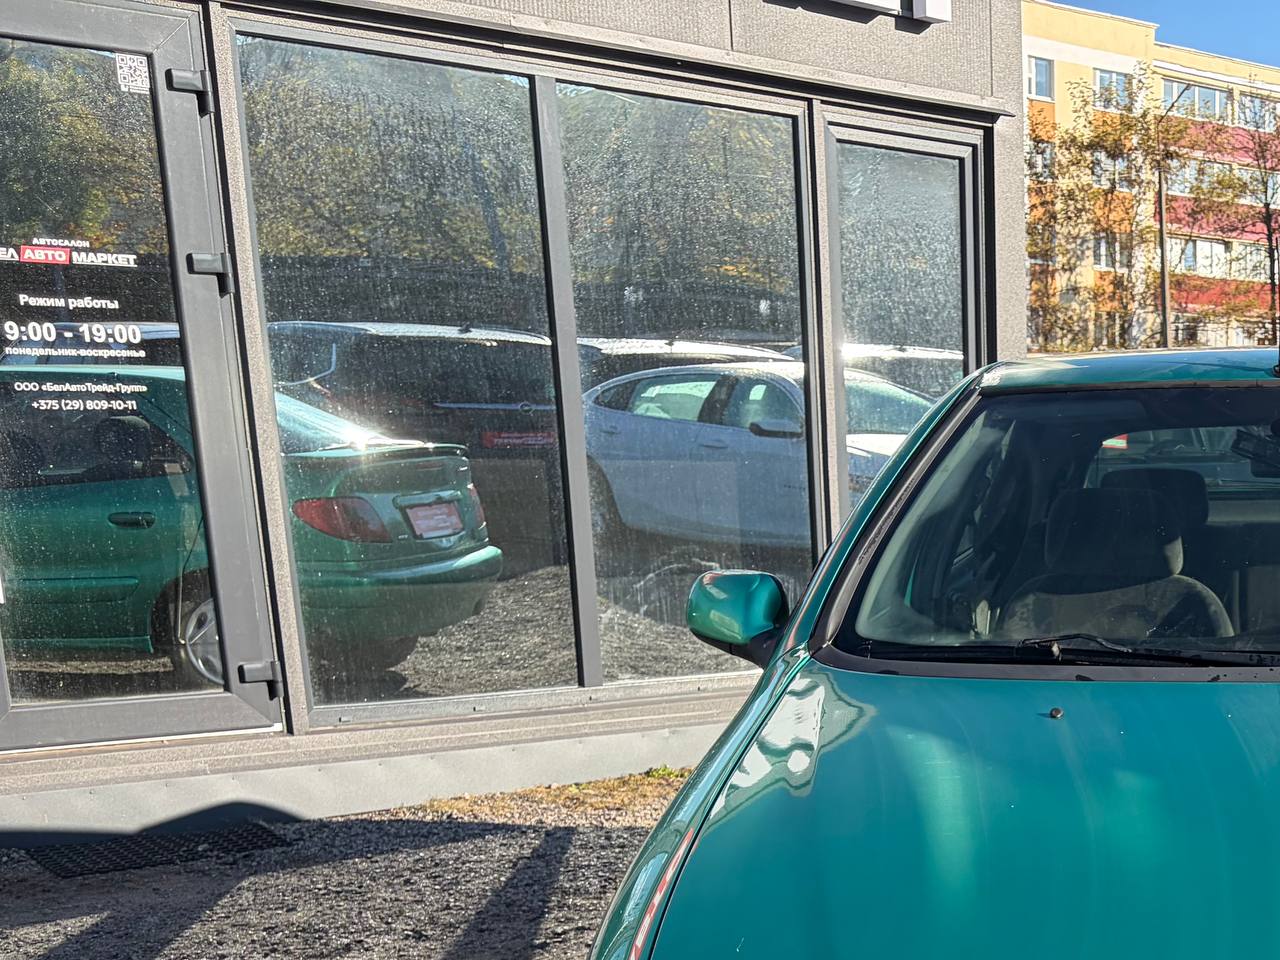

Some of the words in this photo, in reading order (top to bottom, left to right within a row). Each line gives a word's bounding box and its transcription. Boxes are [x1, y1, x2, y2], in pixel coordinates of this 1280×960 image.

[32, 237, 90, 248] АВТОСАЛОН
[23, 249, 66, 261] АВТО
[71, 251, 138, 267] МАРКЕТ
[18, 294, 66, 307] Режим
[68, 296, 119, 310] работы
[4, 320, 57, 341] 9:00
[79, 323, 142, 343] 19:00
[5, 346, 146, 358] понедельник-воскресенье
[14, 382, 39, 391] ООО
[31, 400, 60, 410] +375
[61, 399, 84, 411] (29)
[86, 400, 137, 411] 809-10-11
